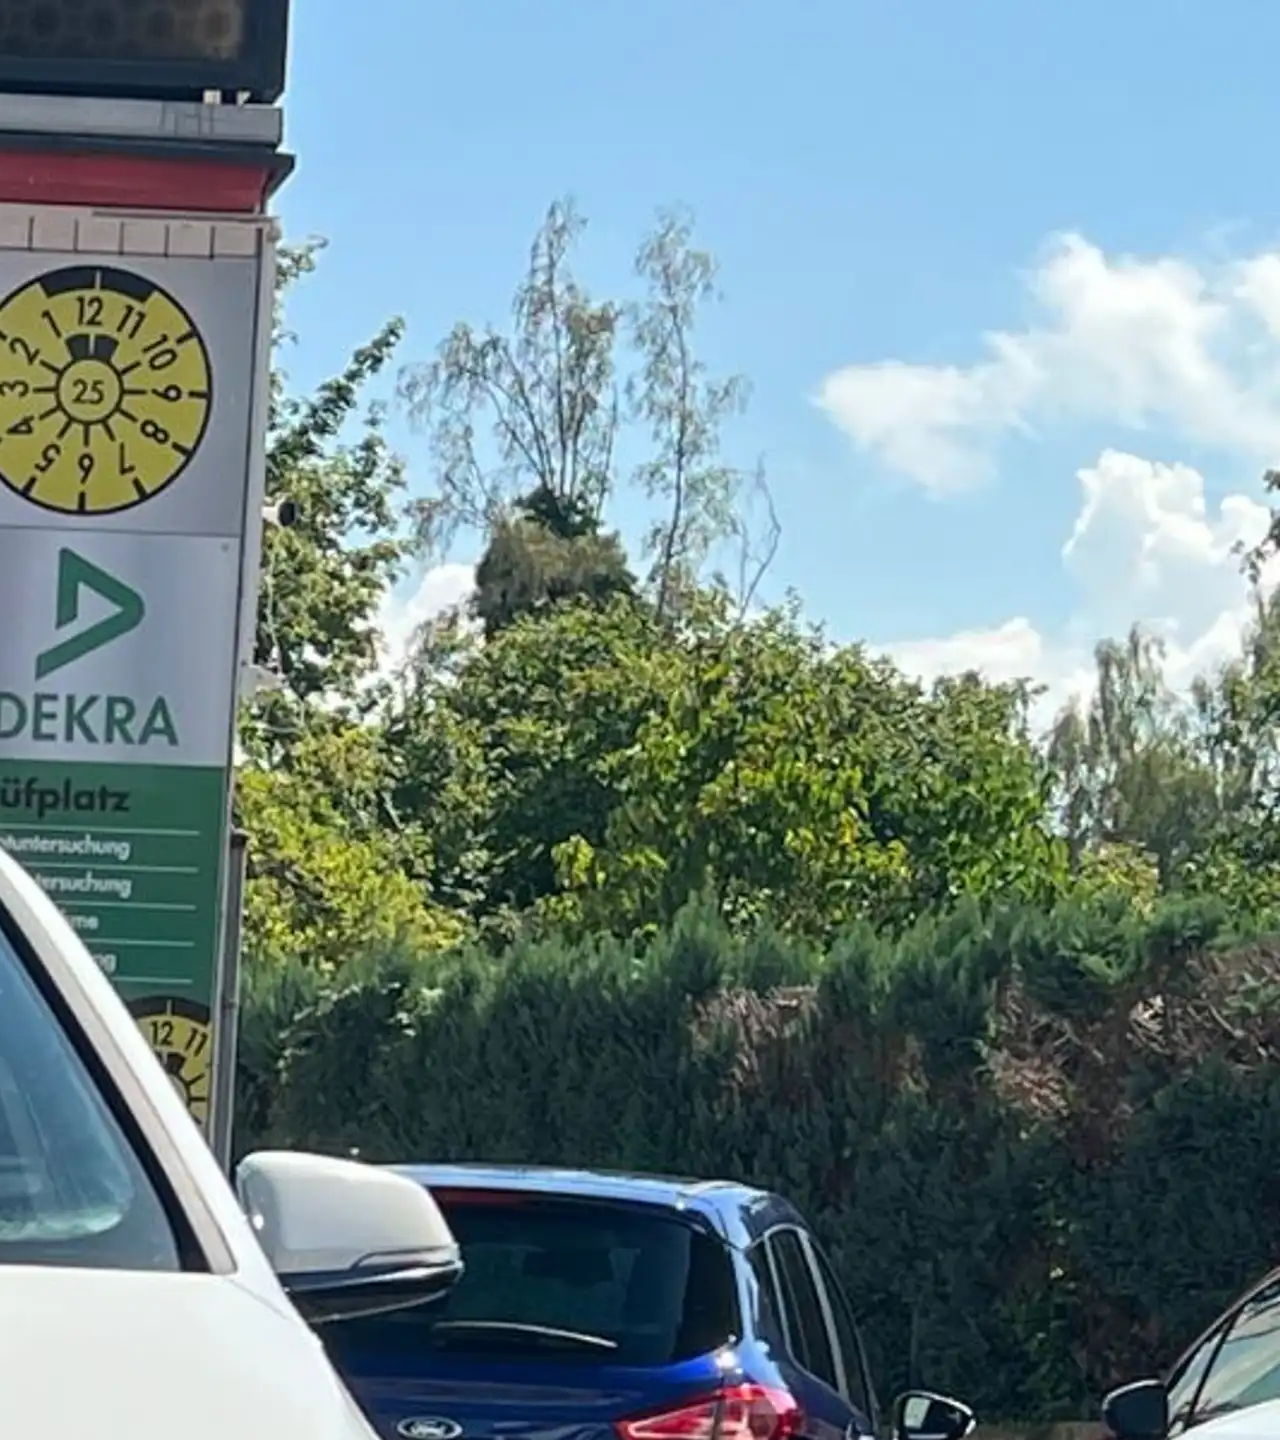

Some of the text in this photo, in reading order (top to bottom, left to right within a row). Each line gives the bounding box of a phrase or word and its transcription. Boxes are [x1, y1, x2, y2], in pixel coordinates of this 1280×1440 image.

[41, 310, 62, 338] 1
[76, 296, 103, 326] 12
[117, 305, 146, 339] 11
[9, 337, 40, 365] 2
[142, 334, 177, 370] 10
[72, 379, 104, 404] 25
[6, 416, 34, 434] 4
[141, 420, 169, 444] 8
[35, 444, 61, 472] 5
[150, 1020, 173, 1046] 12
[185, 1027, 209, 1057] 11
